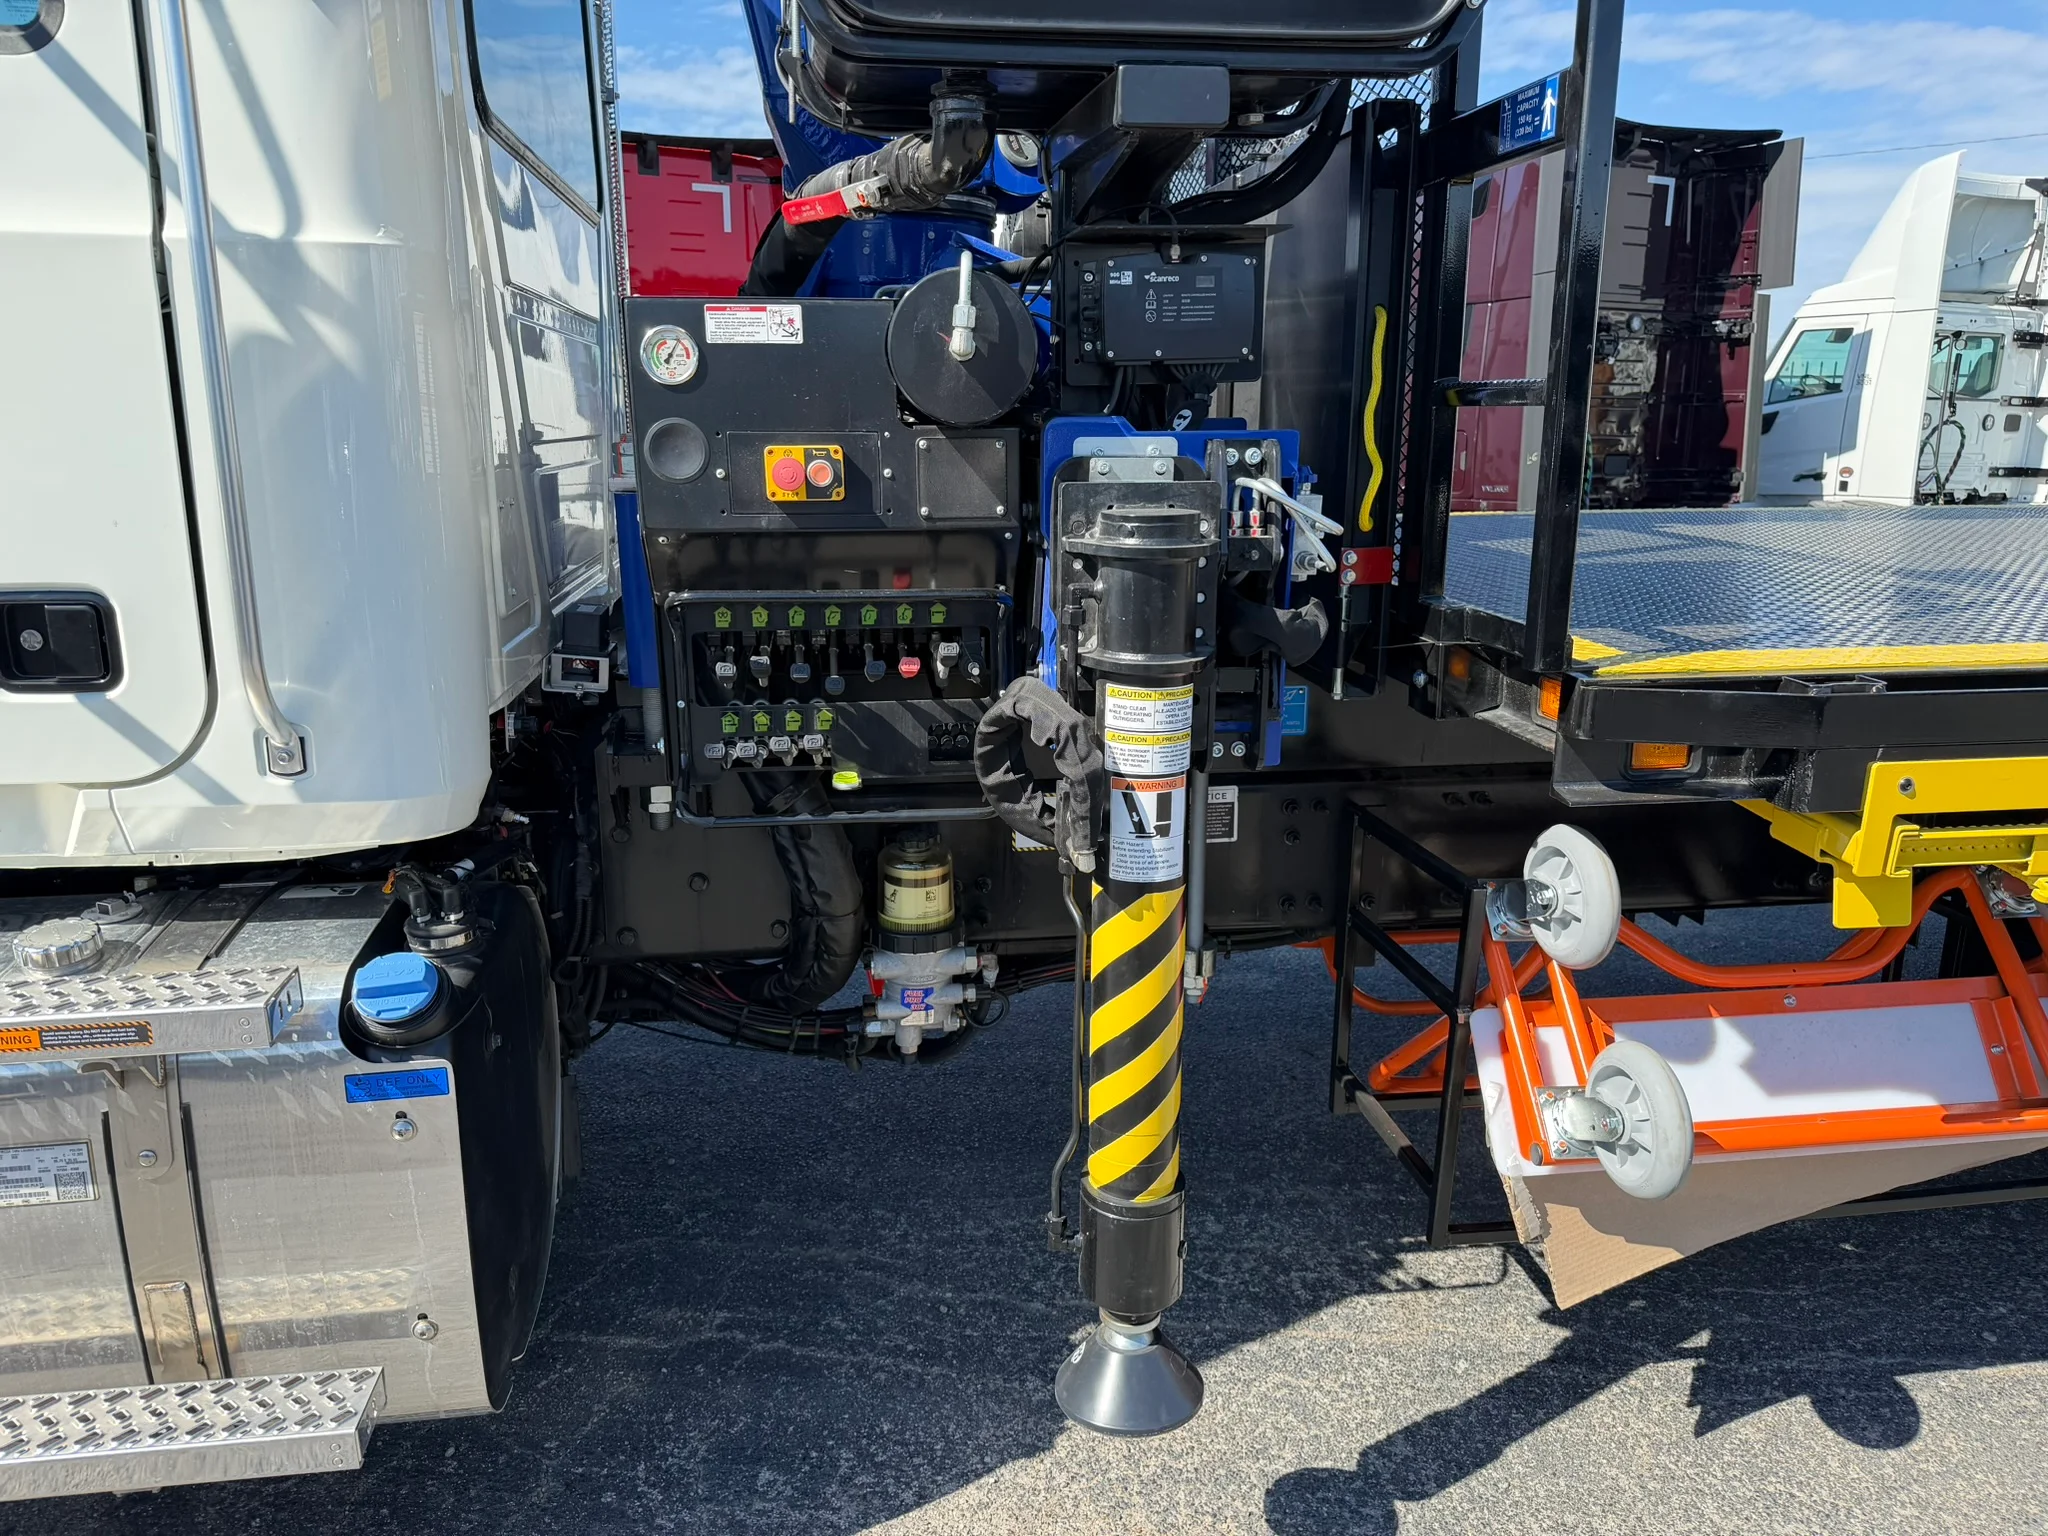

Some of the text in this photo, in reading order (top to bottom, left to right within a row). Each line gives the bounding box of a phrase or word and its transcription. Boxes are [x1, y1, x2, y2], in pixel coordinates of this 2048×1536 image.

[1518, 86, 1540, 102] MAXIMUM
[1516, 97, 1540, 113] CAPACITY
[1526, 114, 1532, 123] kg
[1117, 690, 1152, 698] CAUTION
[1117, 735, 1147, 743] CAUTION
[1136, 780, 1177, 790] WARNING
[0, 1036, 32, 1044] NING
[376, 1074, 440, 1087] DEF ONLY
